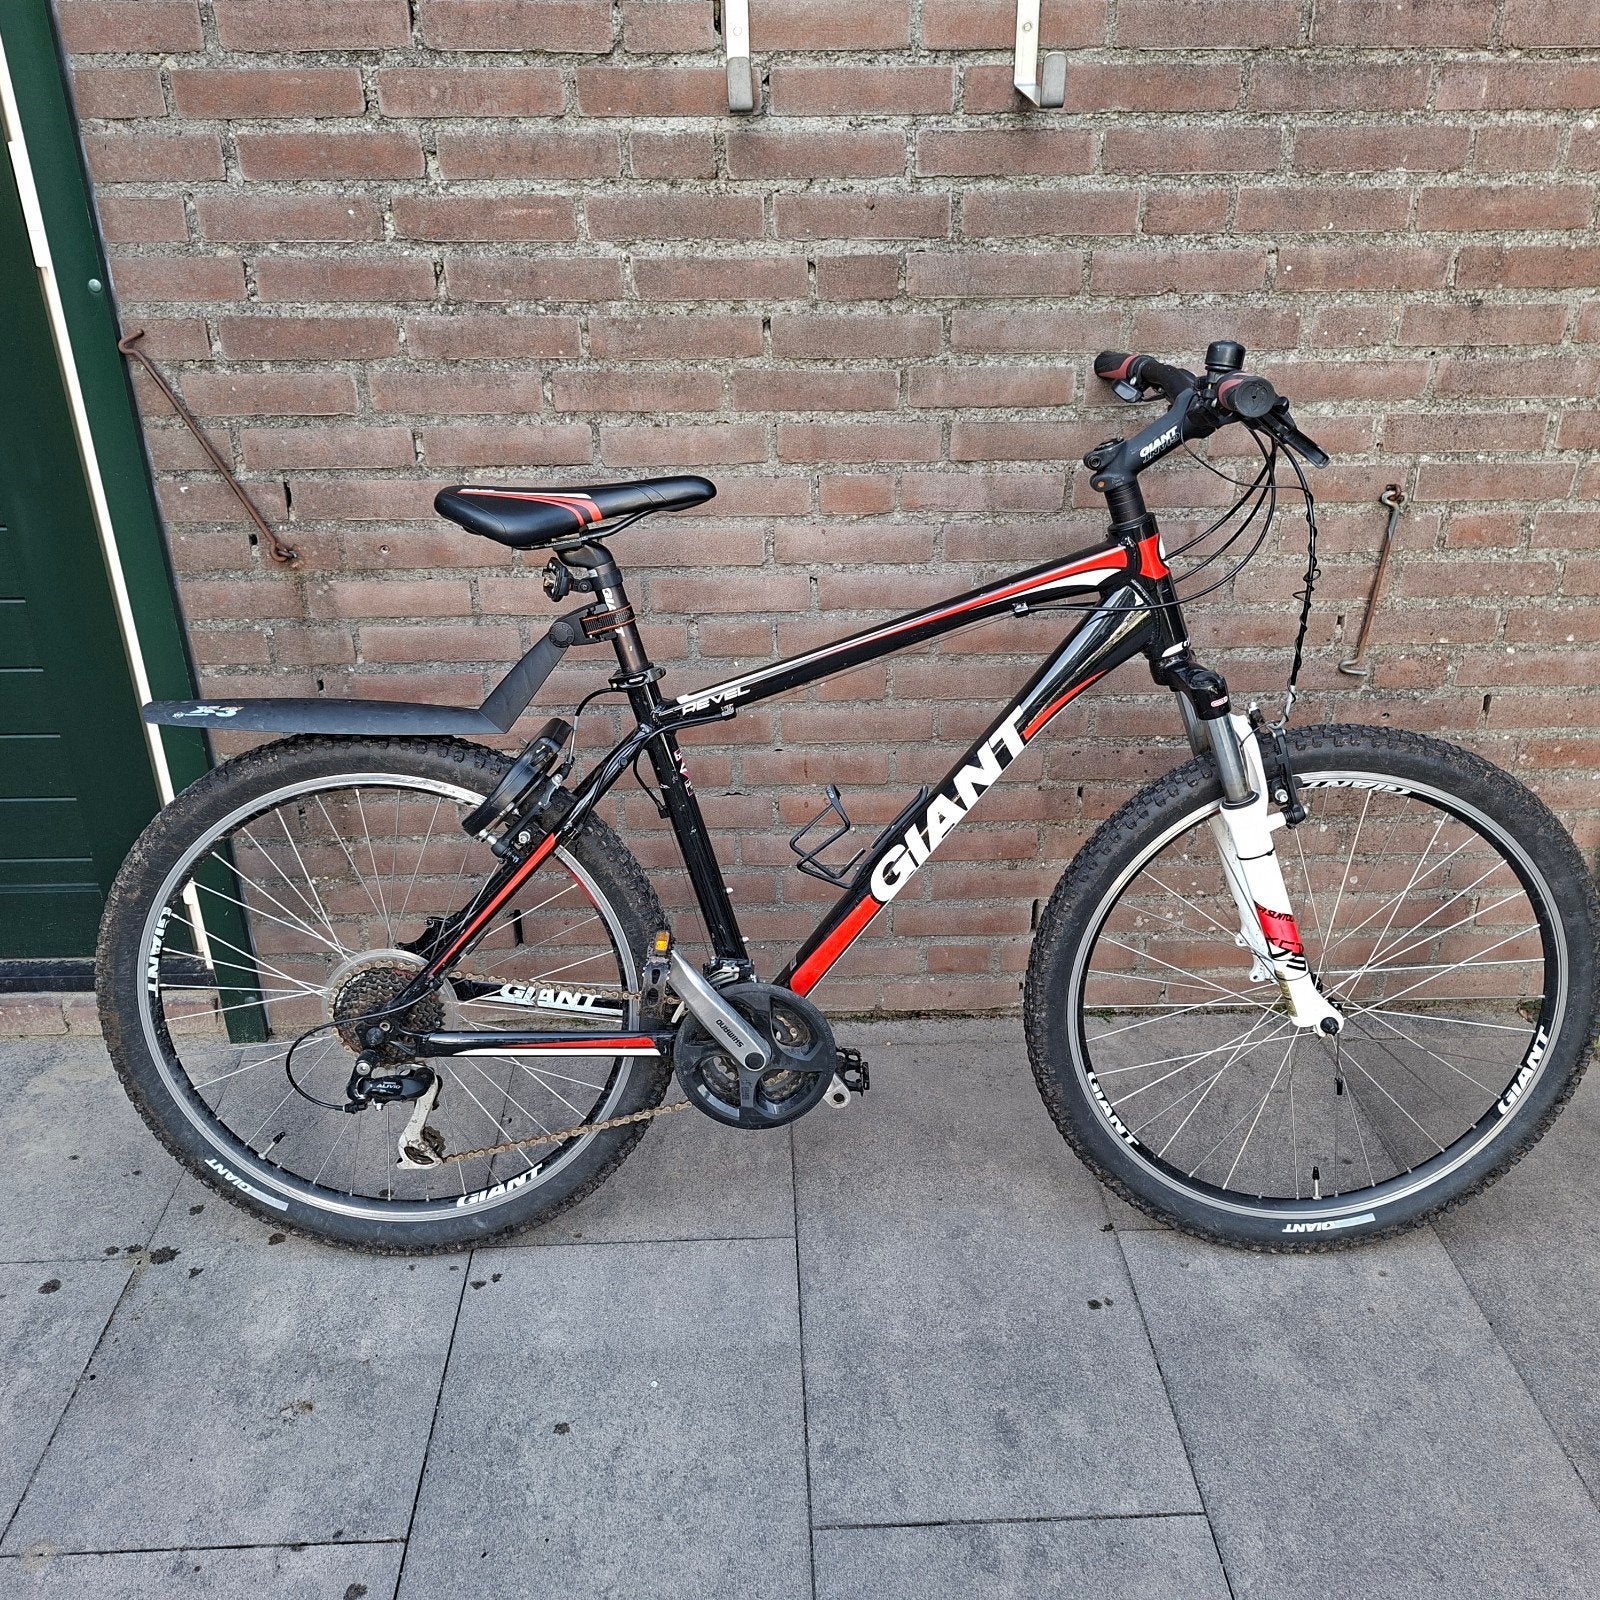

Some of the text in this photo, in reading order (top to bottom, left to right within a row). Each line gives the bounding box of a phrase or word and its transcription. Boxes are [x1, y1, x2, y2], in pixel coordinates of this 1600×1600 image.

[1140, 425, 1178, 458] GIANT
[602, 587, 626, 638] GIAT
[682, 687, 750, 716] REVEL
[870, 705, 1026, 902] GIANT
[147, 906, 173, 998] GIANT
[499, 983, 603, 1009] GIANT
[715, 1019, 745, 1048] SHIMANO
[1497, 1025, 1549, 1115] GIANT
[1087, 1071, 1140, 1145] GIANT
[203, 1158, 253, 1193] GIANT
[456, 1162, 543, 1208] GIANT
[1281, 1221, 1335, 1233] GIANT
